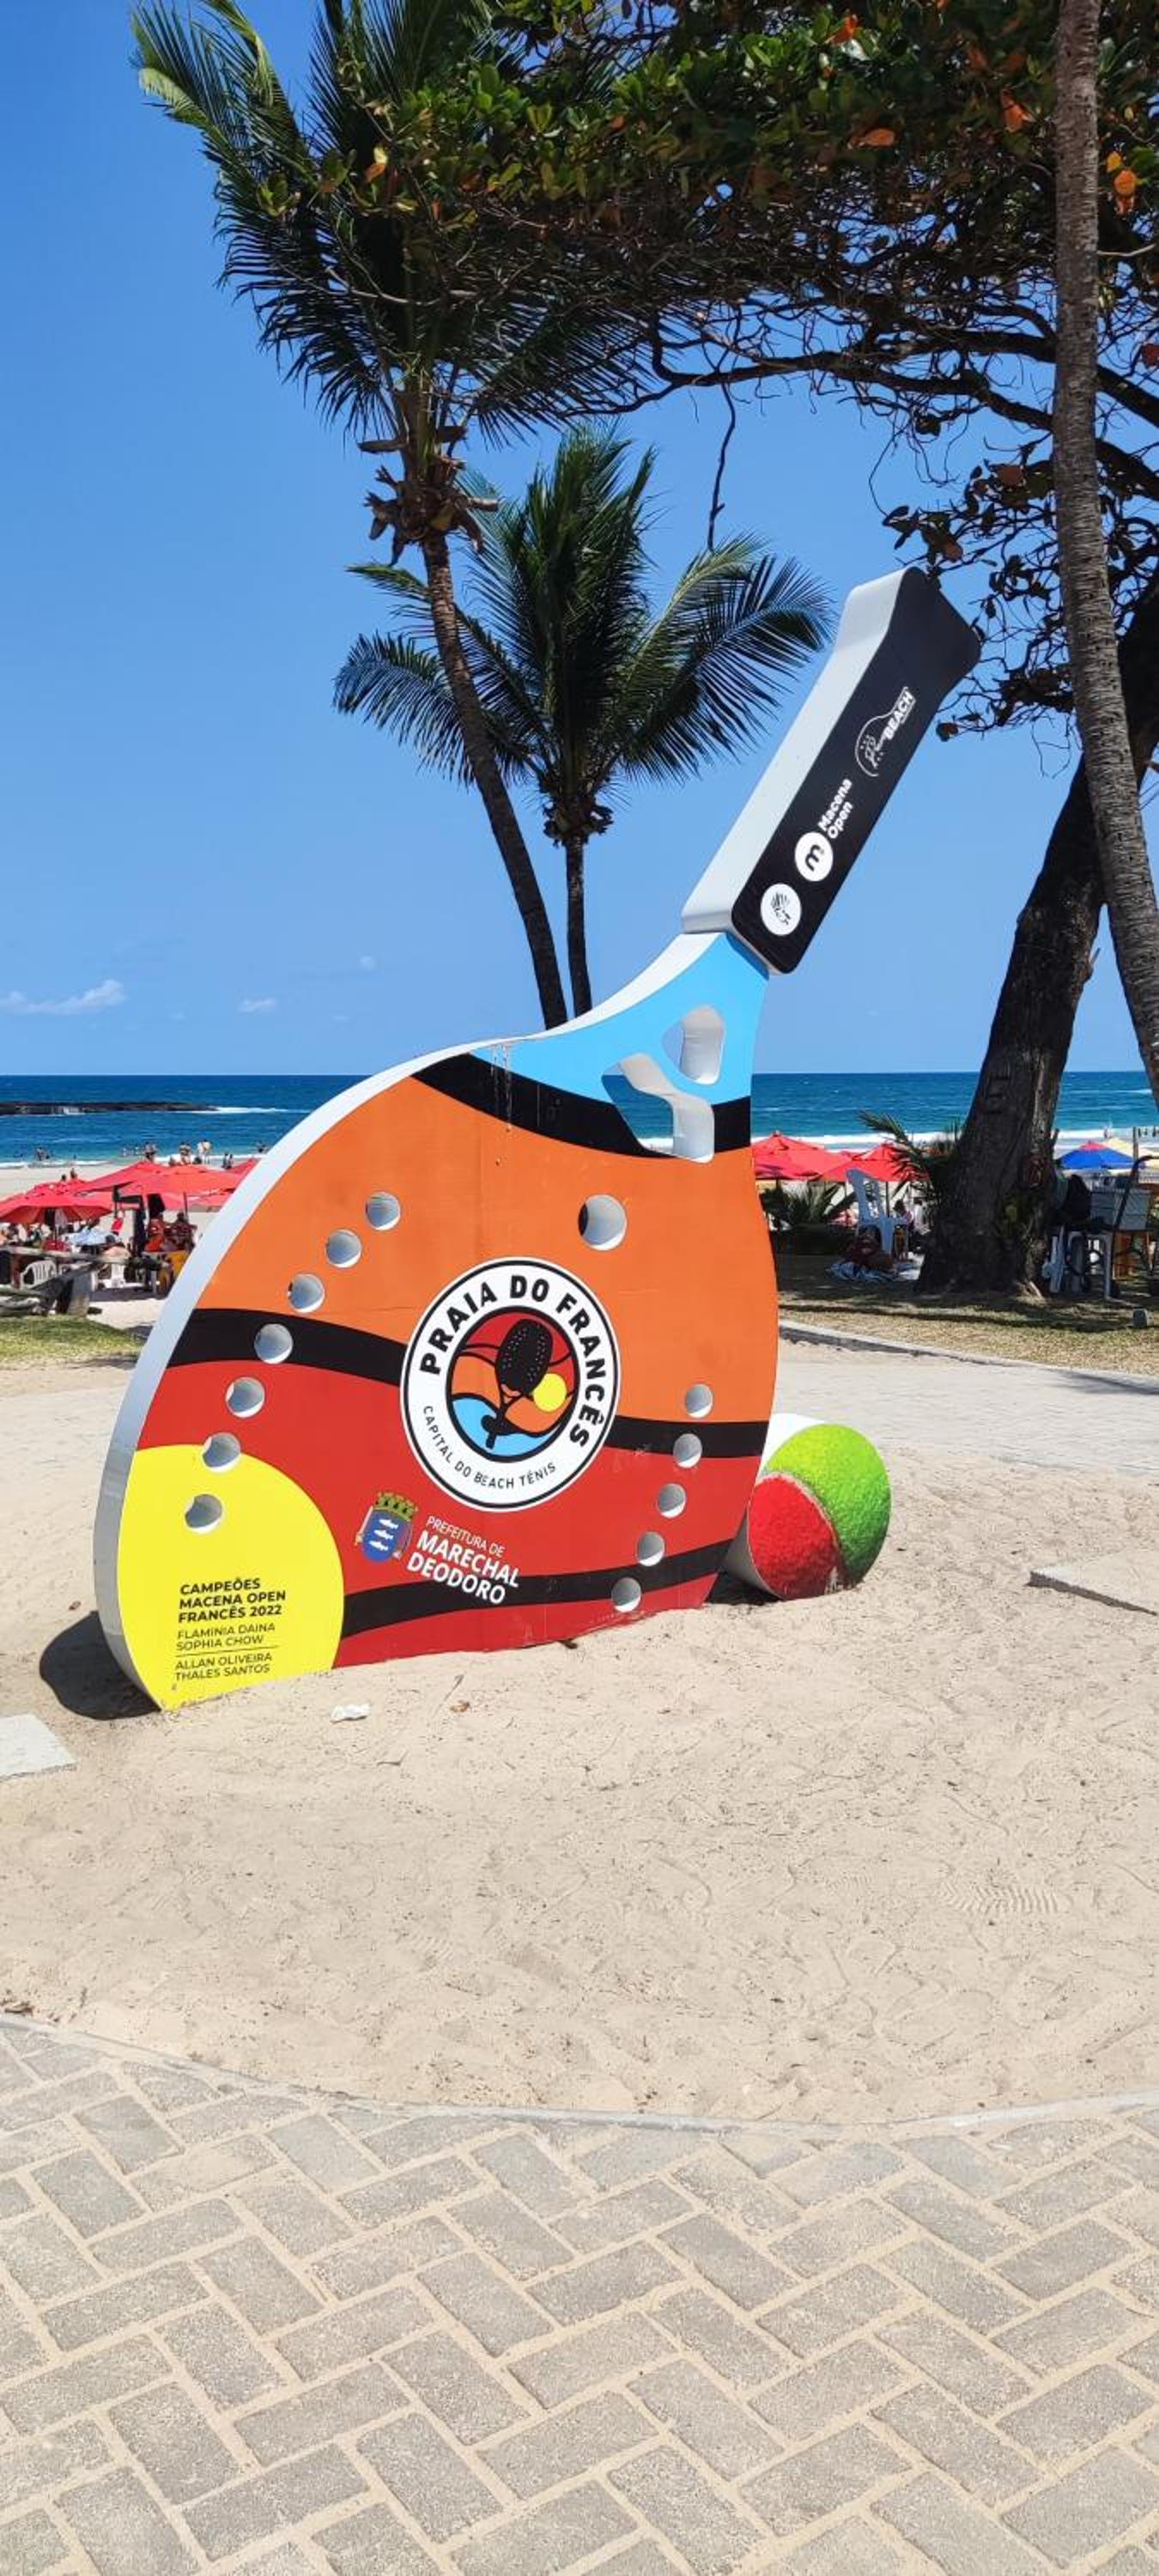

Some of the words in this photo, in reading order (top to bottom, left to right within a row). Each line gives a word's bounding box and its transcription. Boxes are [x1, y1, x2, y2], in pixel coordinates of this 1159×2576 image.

[884, 690, 913, 740] BEACH
[818, 779, 853, 832] Macena
[828, 801, 853, 839] Open
[420, 1282, 498, 1376] PRAIA
[510, 1275, 550, 1303] DO
[555, 1292, 607, 1449] FRANCÊS
[423, 1406, 457, 1464] CAPITAL
[454, 1461, 476, 1478] DO
[474, 1472, 514, 1490] BEACH
[426, 1516, 487, 1551] PREFEITURA
[488, 1543, 506, 1558] DE
[407, 1552, 507, 1604] DEODORO
[416, 1530, 520, 1588] MARECHAL
[179, 1577, 261, 1595] CAMPEÕES
[179, 1595, 243, 1610] MACENA
[246, 1590, 286, 1604] OPEN
[178, 1606, 246, 1623] FRANCÊS
[250, 1605, 282, 1617] 2022
[175, 1656, 215, 1670] ALLAN
[218, 1652, 273, 1666] OLIVEIRA
[176, 1637, 222, 1651] SOPHIA
[225, 1634, 264, 1647] CHOW
[176, 1668, 221, 1681] THALES
[224, 1663, 270, 1676] SANTOS
